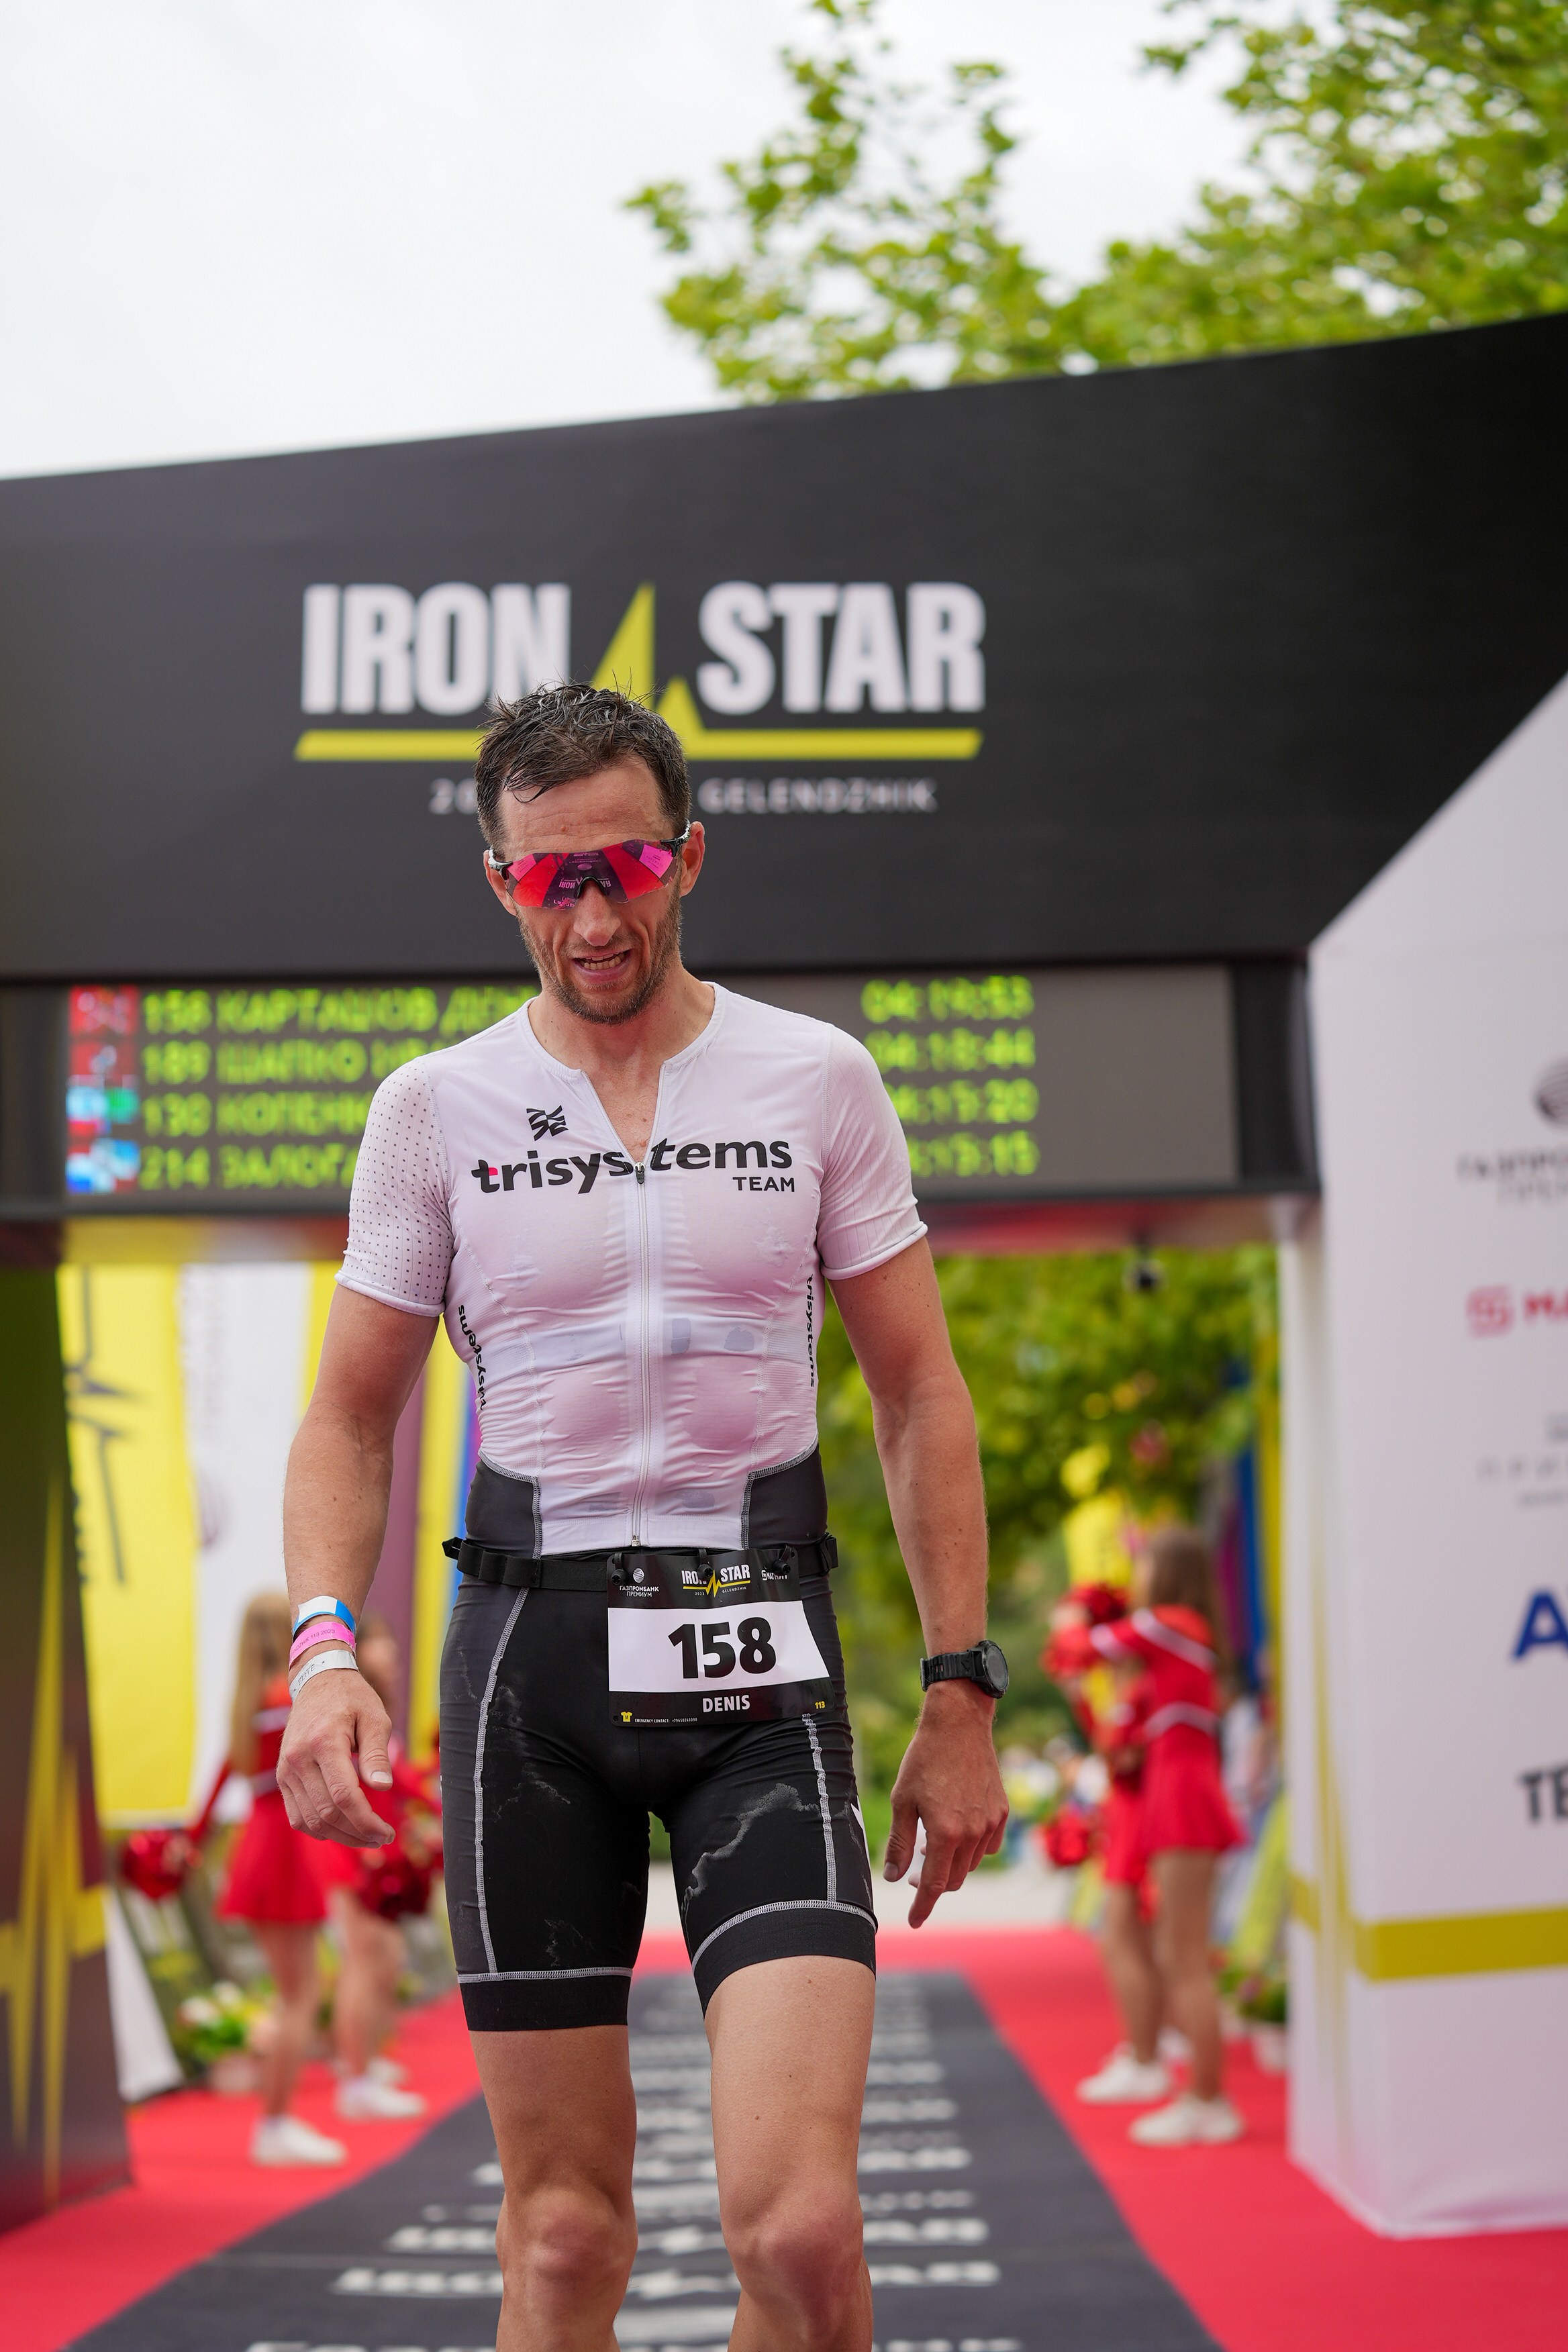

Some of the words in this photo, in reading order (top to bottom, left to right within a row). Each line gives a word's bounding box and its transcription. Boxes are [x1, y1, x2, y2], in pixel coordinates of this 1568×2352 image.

[301, 583, 571, 714] IRON
[698, 581, 985, 714] STAR
[430, 779, 474, 814] 20
[699, 778, 936, 814] GELENDZHIK
[217, 987, 437, 1032] КАРТАШОВ
[471, 1138, 792, 1194] trisystems
[733, 1177, 795, 1192] TEAM
[458, 1304, 487, 1410] trisystems
[720, 1565, 750, 1582] STAR
[668, 1617, 777, 1679] 158
[298, 1664, 316, 1685] ELITE
[703, 1695, 750, 1712] DENIS
[815, 1701, 826, 1709] 113
